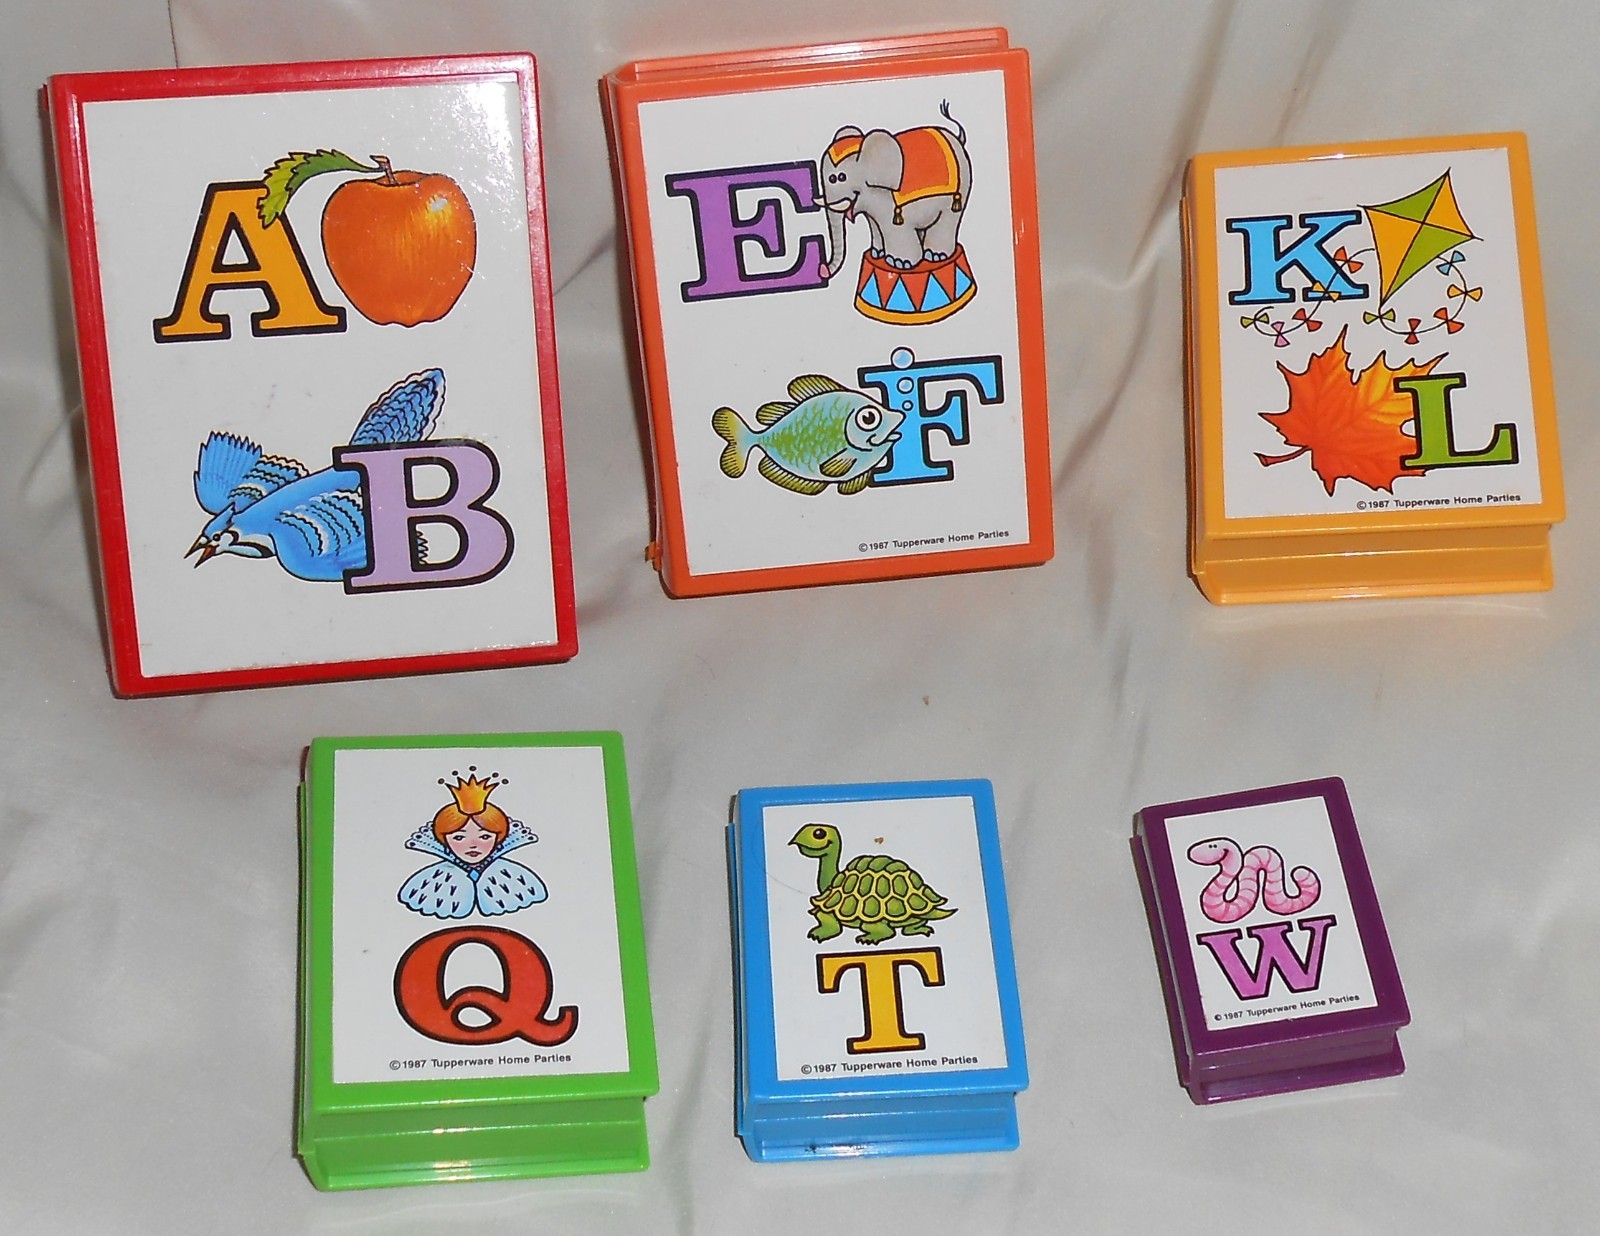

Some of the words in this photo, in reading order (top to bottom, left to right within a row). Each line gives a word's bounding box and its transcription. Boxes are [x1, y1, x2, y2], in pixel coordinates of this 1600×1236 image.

[153, 180, 347, 343] A
[666, 160, 831, 301] E
[1225, 211, 1371, 306] K
[858, 354, 1005, 486] F
[1394, 372, 1520, 470] L
[333, 439, 515, 594] B
[891, 536, 945, 549] Tupperware
[947, 533, 975, 543] Home
[977, 530, 1010, 540] Parties
[1393, 498, 1450, 509] Tupperware
[1453, 496, 1483, 505] Home
[1486, 494, 1521, 504] Parties
[394, 926, 578, 1046] Q
[816, 947, 945, 1055] T
[1197, 915, 1337, 1000] W
[1244, 1003, 1298, 1017] Tupperware
[1299, 999, 1326, 1009] Home
[1327, 994, 1360, 1005] Parties
[430, 1058, 494, 1069] Tupperware
[498, 1055, 530, 1065] Home
[534, 1053, 572, 1063] Parties
[840, 1061, 903, 1073] Tupperware
[906, 1058, 938, 1068] Home
[941, 1055, 978, 1066] Parties
